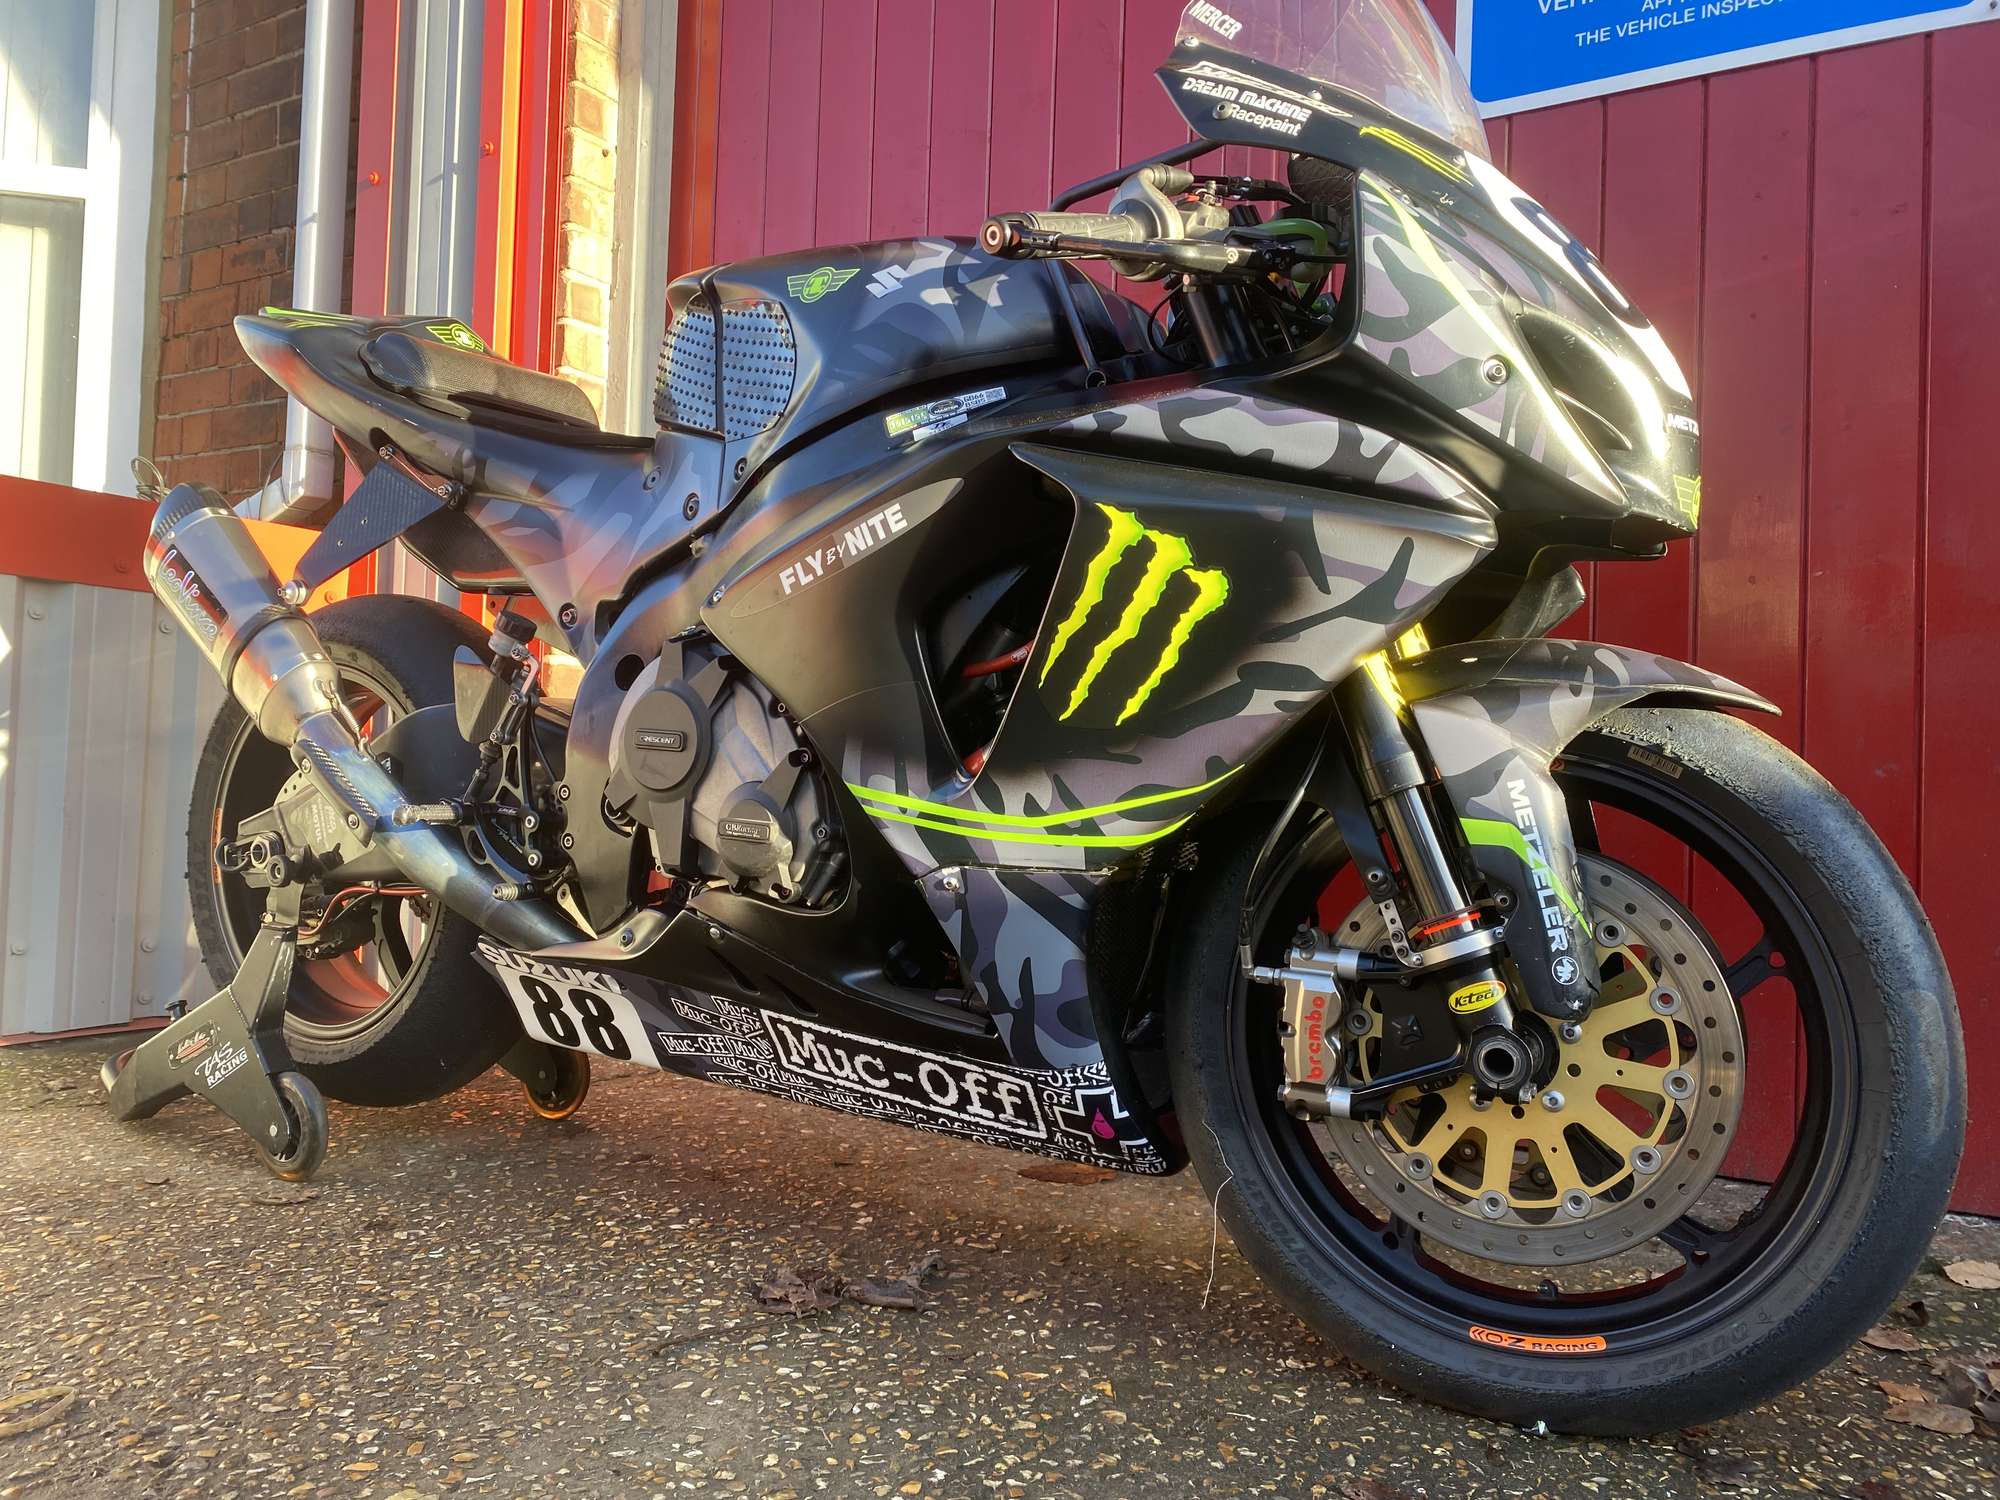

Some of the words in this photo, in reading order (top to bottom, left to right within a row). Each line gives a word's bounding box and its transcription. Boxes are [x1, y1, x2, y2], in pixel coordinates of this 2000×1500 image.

[1189, 1, 1243, 40] MERCER
[1575, 26, 1611, 46] THE
[1616, 7, 1695, 37] VEHICLE
[1182, 77, 1236, 101] DREAM
[1238, 90, 1312, 122] MACHINE
[1230, 103, 1302, 136] Racepaint
[779, 549, 824, 595] FLY
[826, 540, 847, 566] BY
[844, 502, 908, 556] NITE
[1507, 779, 1569, 953] METZELER
[477, 942, 623, 995] SUZUKI
[518, 975, 632, 1061] 88
[1304, 995, 1326, 1081] brembo
[662, 1035, 729, 1054] Muc-Off
[206, 1050, 248, 1087] RACING
[777, 1023, 1028, 1126] Muc-Off
[1531, 1342, 1598, 1352] RACING
